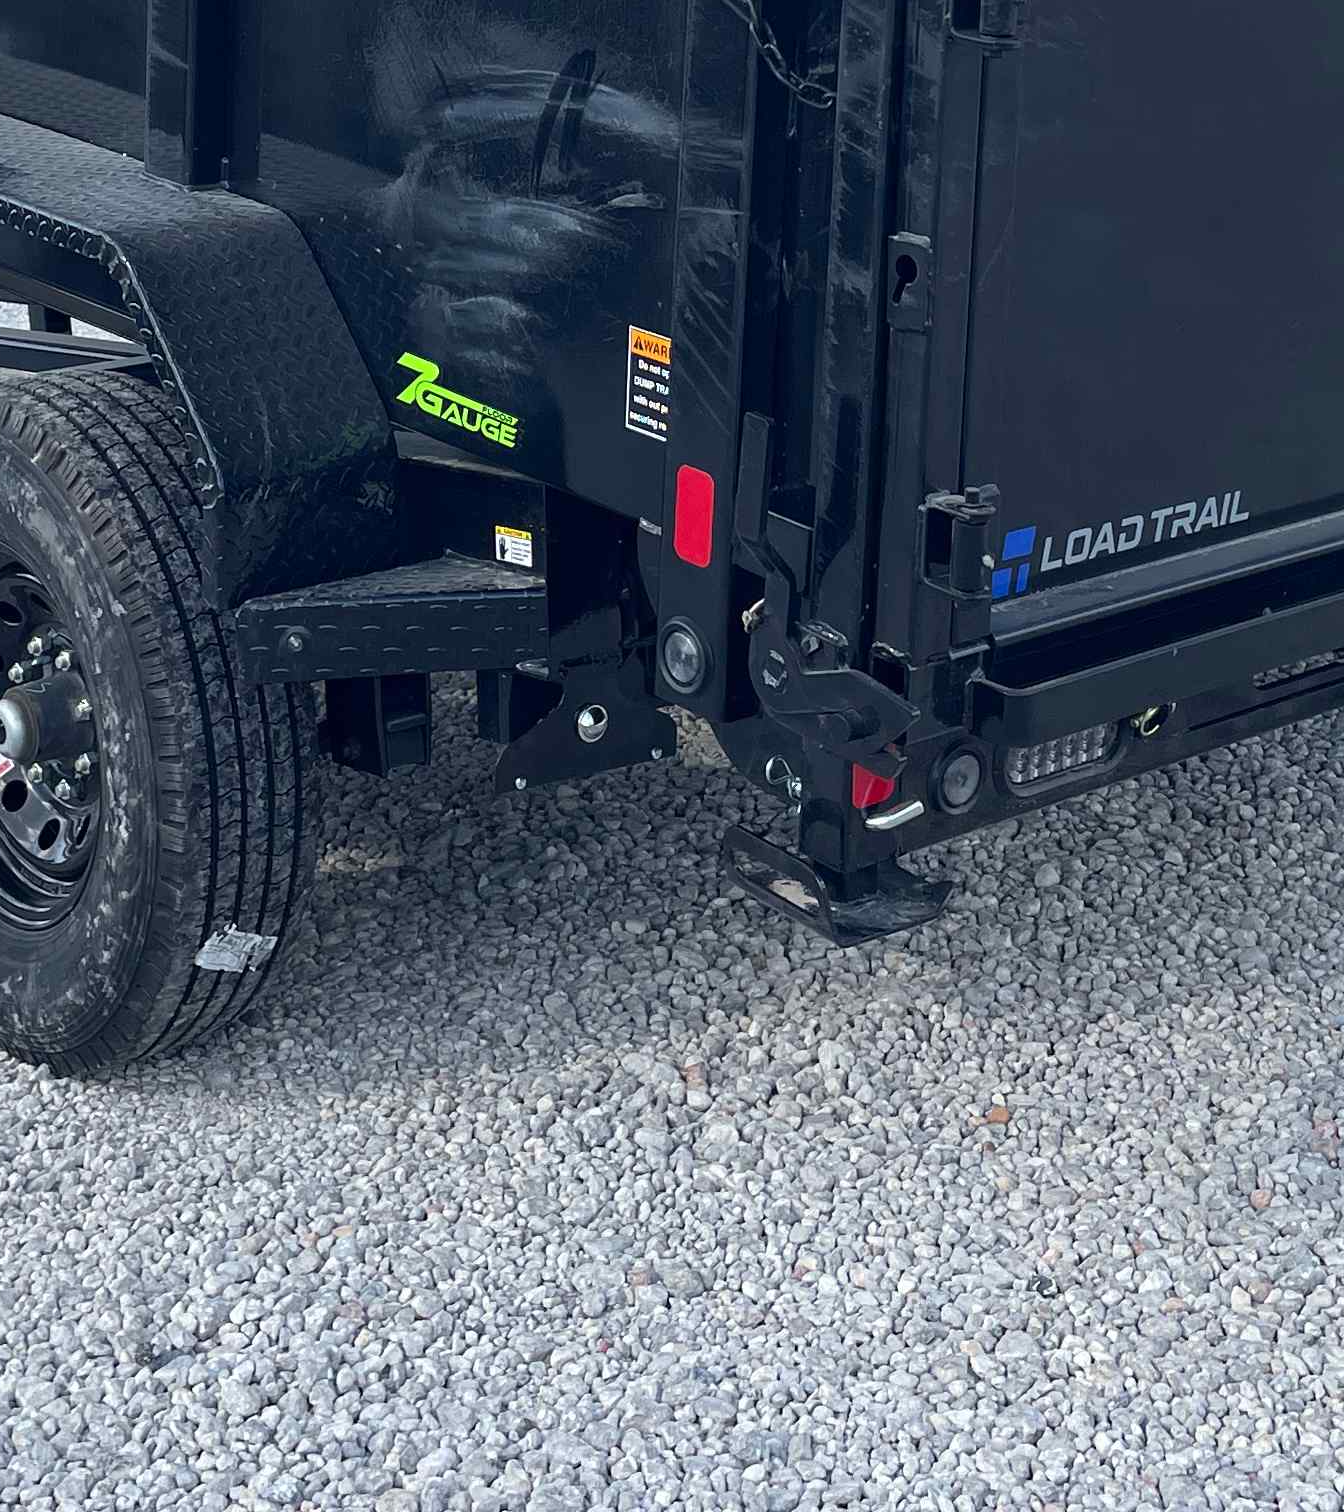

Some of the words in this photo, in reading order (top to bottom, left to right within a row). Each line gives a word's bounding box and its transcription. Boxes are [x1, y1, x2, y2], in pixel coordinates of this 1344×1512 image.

[638, 359, 649, 371] Do
[649, 363, 661, 376] not
[396, 352, 439, 404] 7
[633, 375, 655, 391] DUMP
[633, 394, 648, 408] with
[648, 400, 661, 411] out
[416, 381, 518, 448] GAUGE
[482, 406, 513, 423] FLOOR
[629, 410, 658, 431] securing
[1040, 514, 1145, 572] LOAD
[1151, 490, 1250, 543] TRAIL
